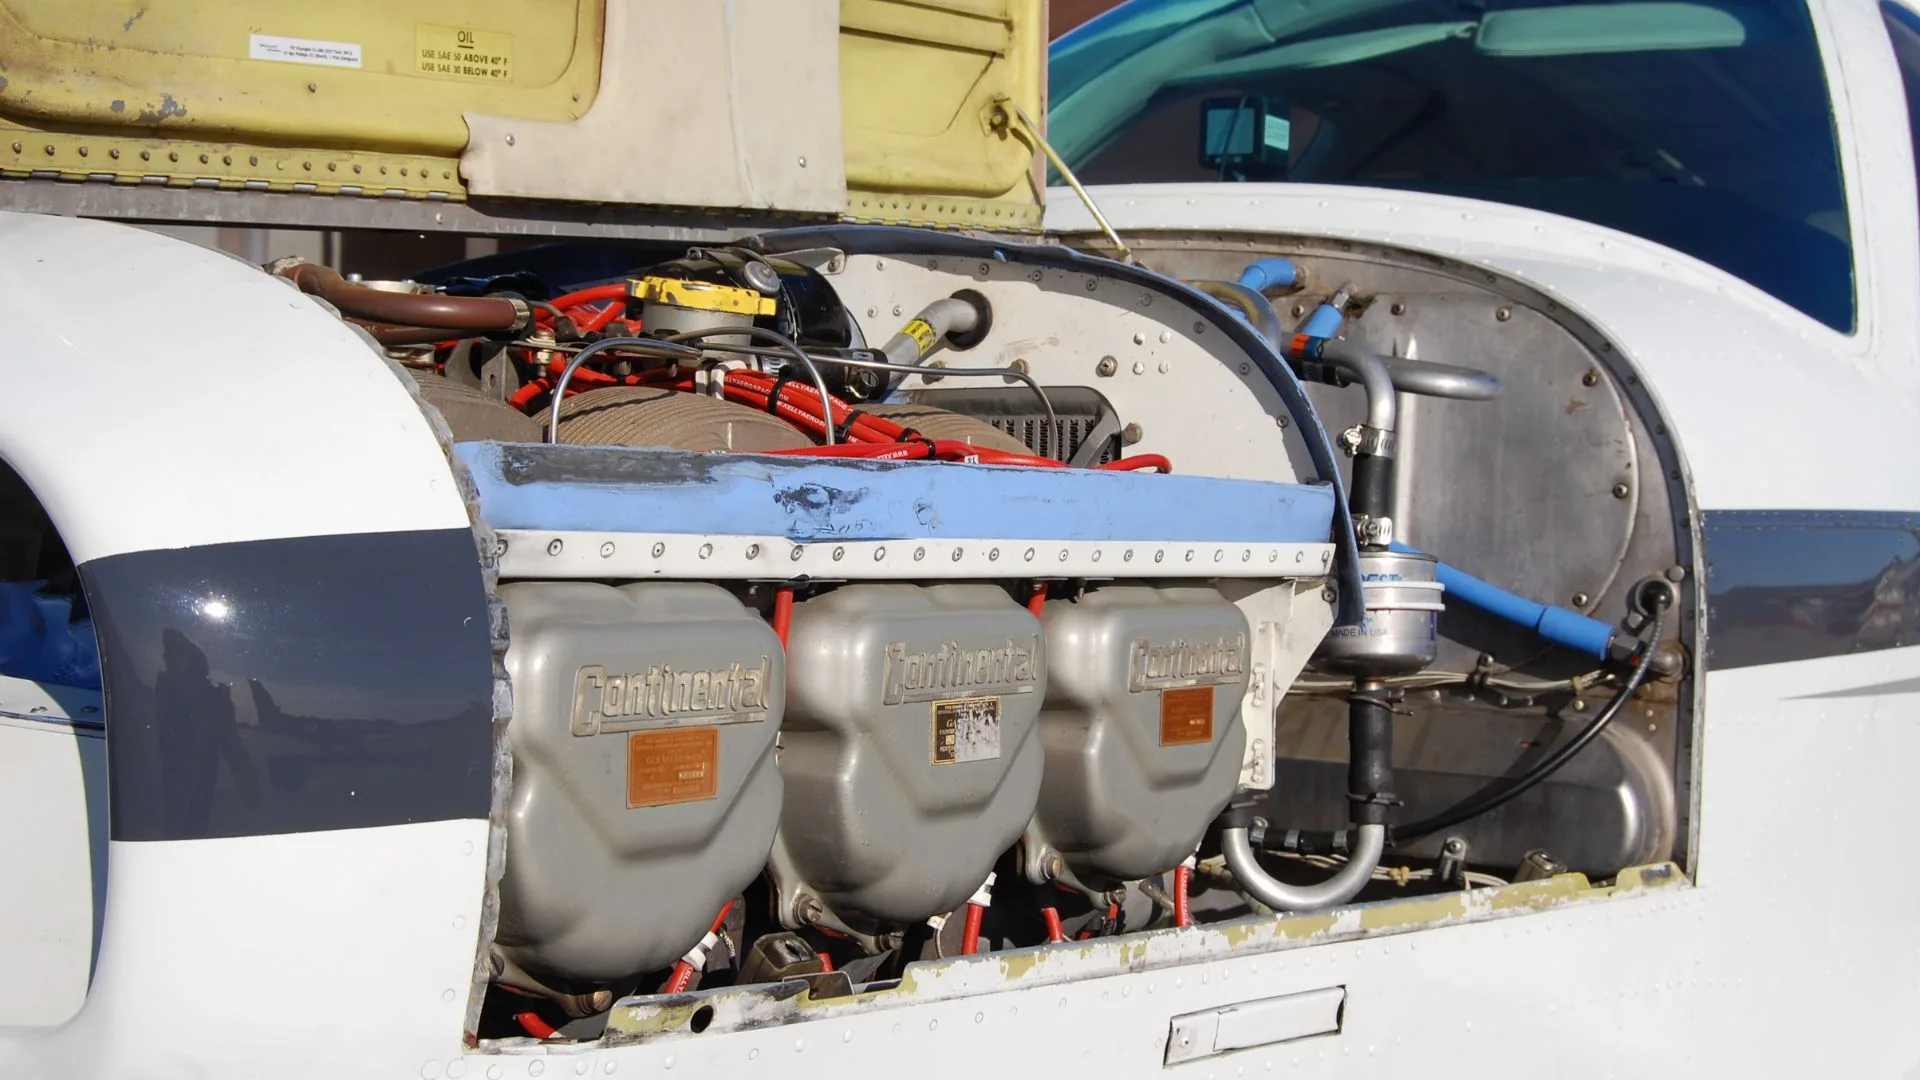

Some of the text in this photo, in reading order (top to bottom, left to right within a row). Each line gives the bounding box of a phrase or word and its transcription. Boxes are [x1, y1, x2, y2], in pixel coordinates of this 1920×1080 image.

[457, 30, 474, 44] OIL
[422, 49, 435, 59] USE
[438, 50, 451, 61] SAE
[463, 53, 489, 65] ABOVE
[422, 62, 435, 71] USE
[437, 63, 451, 73] SAE
[463, 66, 489, 77] BELOW
[1331, 627, 1356, 637] MADE
[1370, 627, 1388, 637] USA
[883, 633, 1039, 706] Continental
[1128, 631, 1245, 693] Continental
[570, 653, 771, 737] Continental
